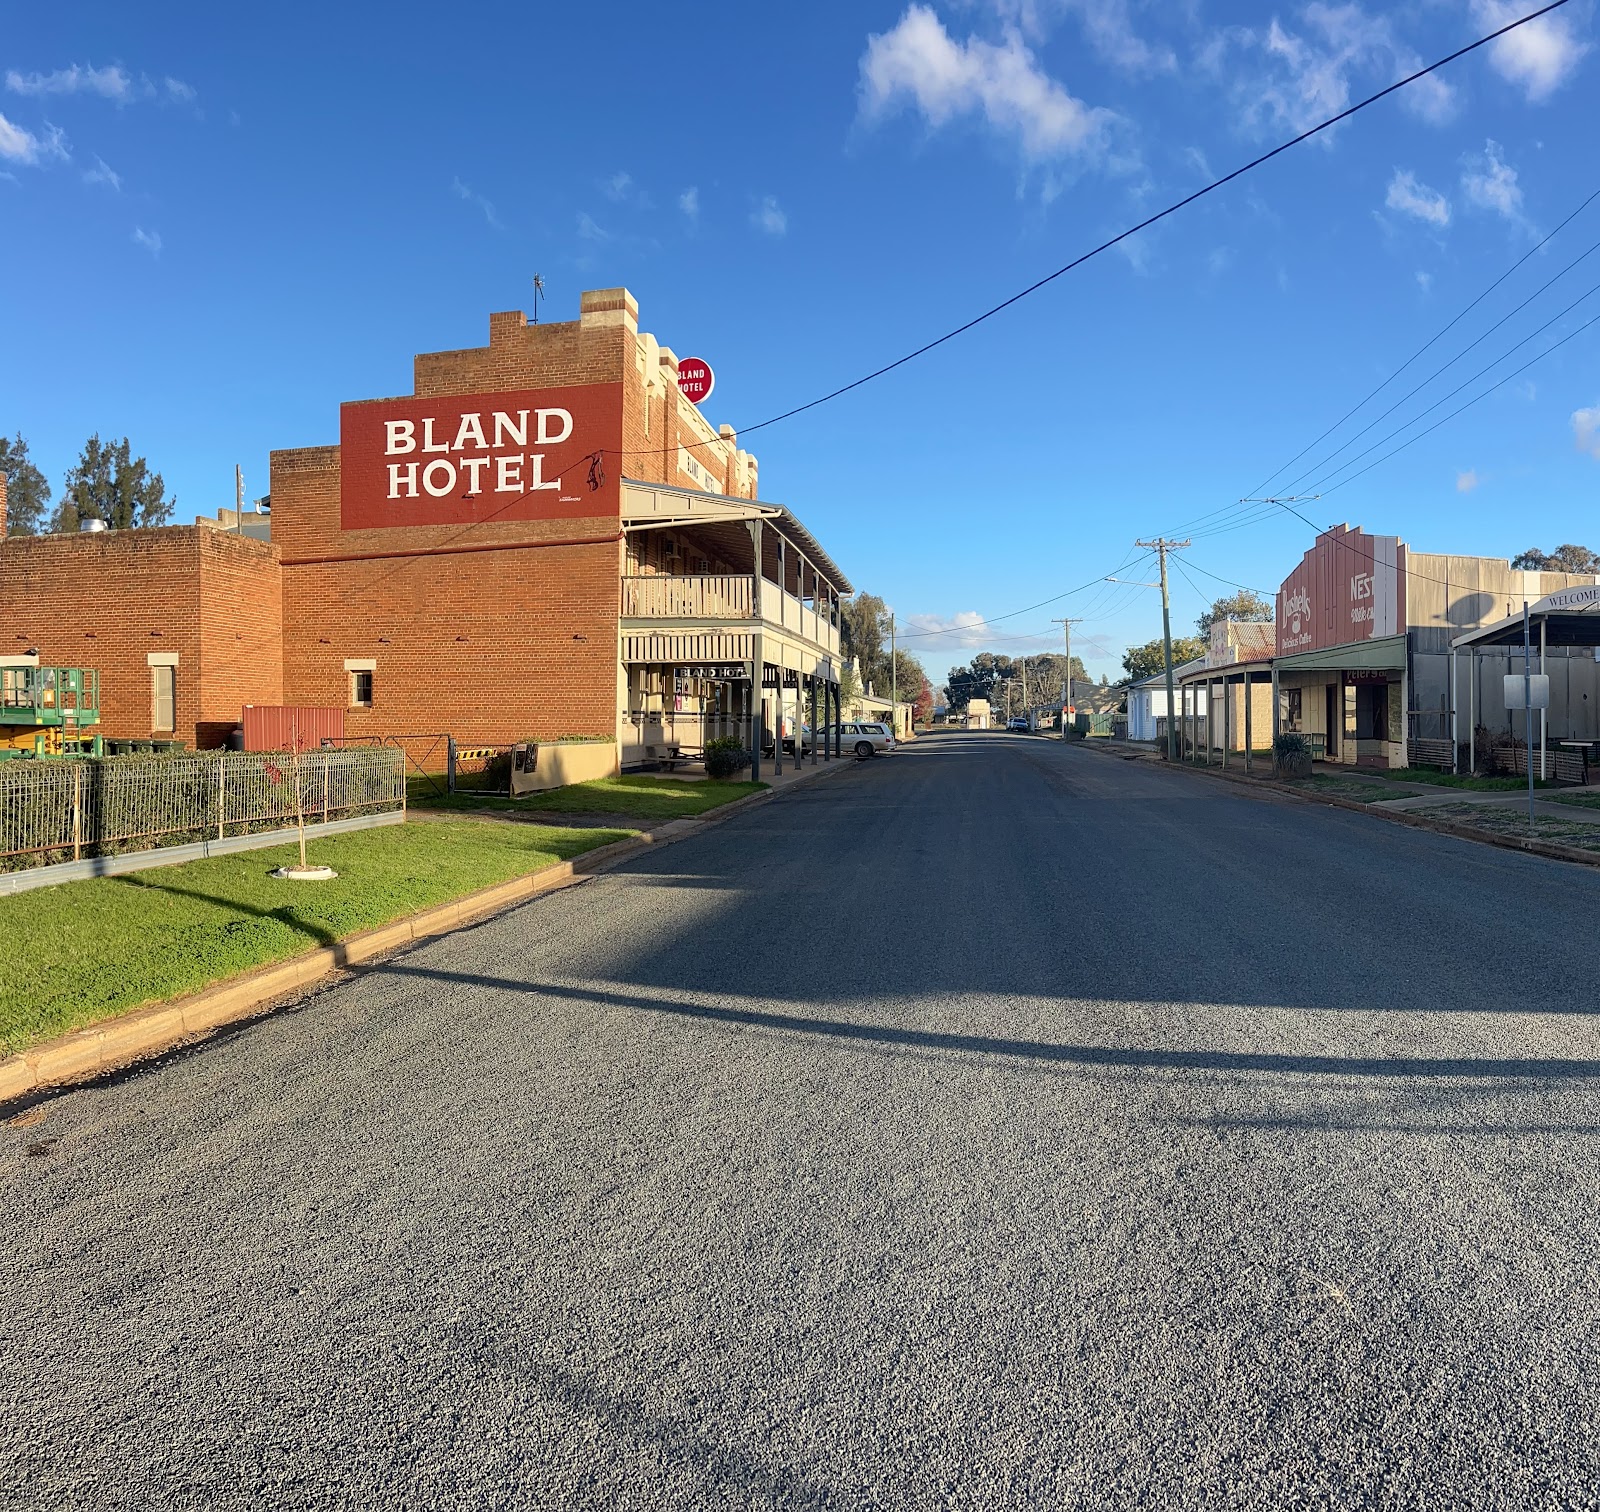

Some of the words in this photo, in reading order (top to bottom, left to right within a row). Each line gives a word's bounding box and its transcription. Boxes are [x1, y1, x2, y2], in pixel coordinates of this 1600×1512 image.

[678, 369, 705, 380] BLAND
[383, 407, 574, 456] BLAND
[386, 452, 562, 499] HOTEL
[1549, 588, 1600, 607] WELCOME
[680, 668, 717, 678] BLAND
